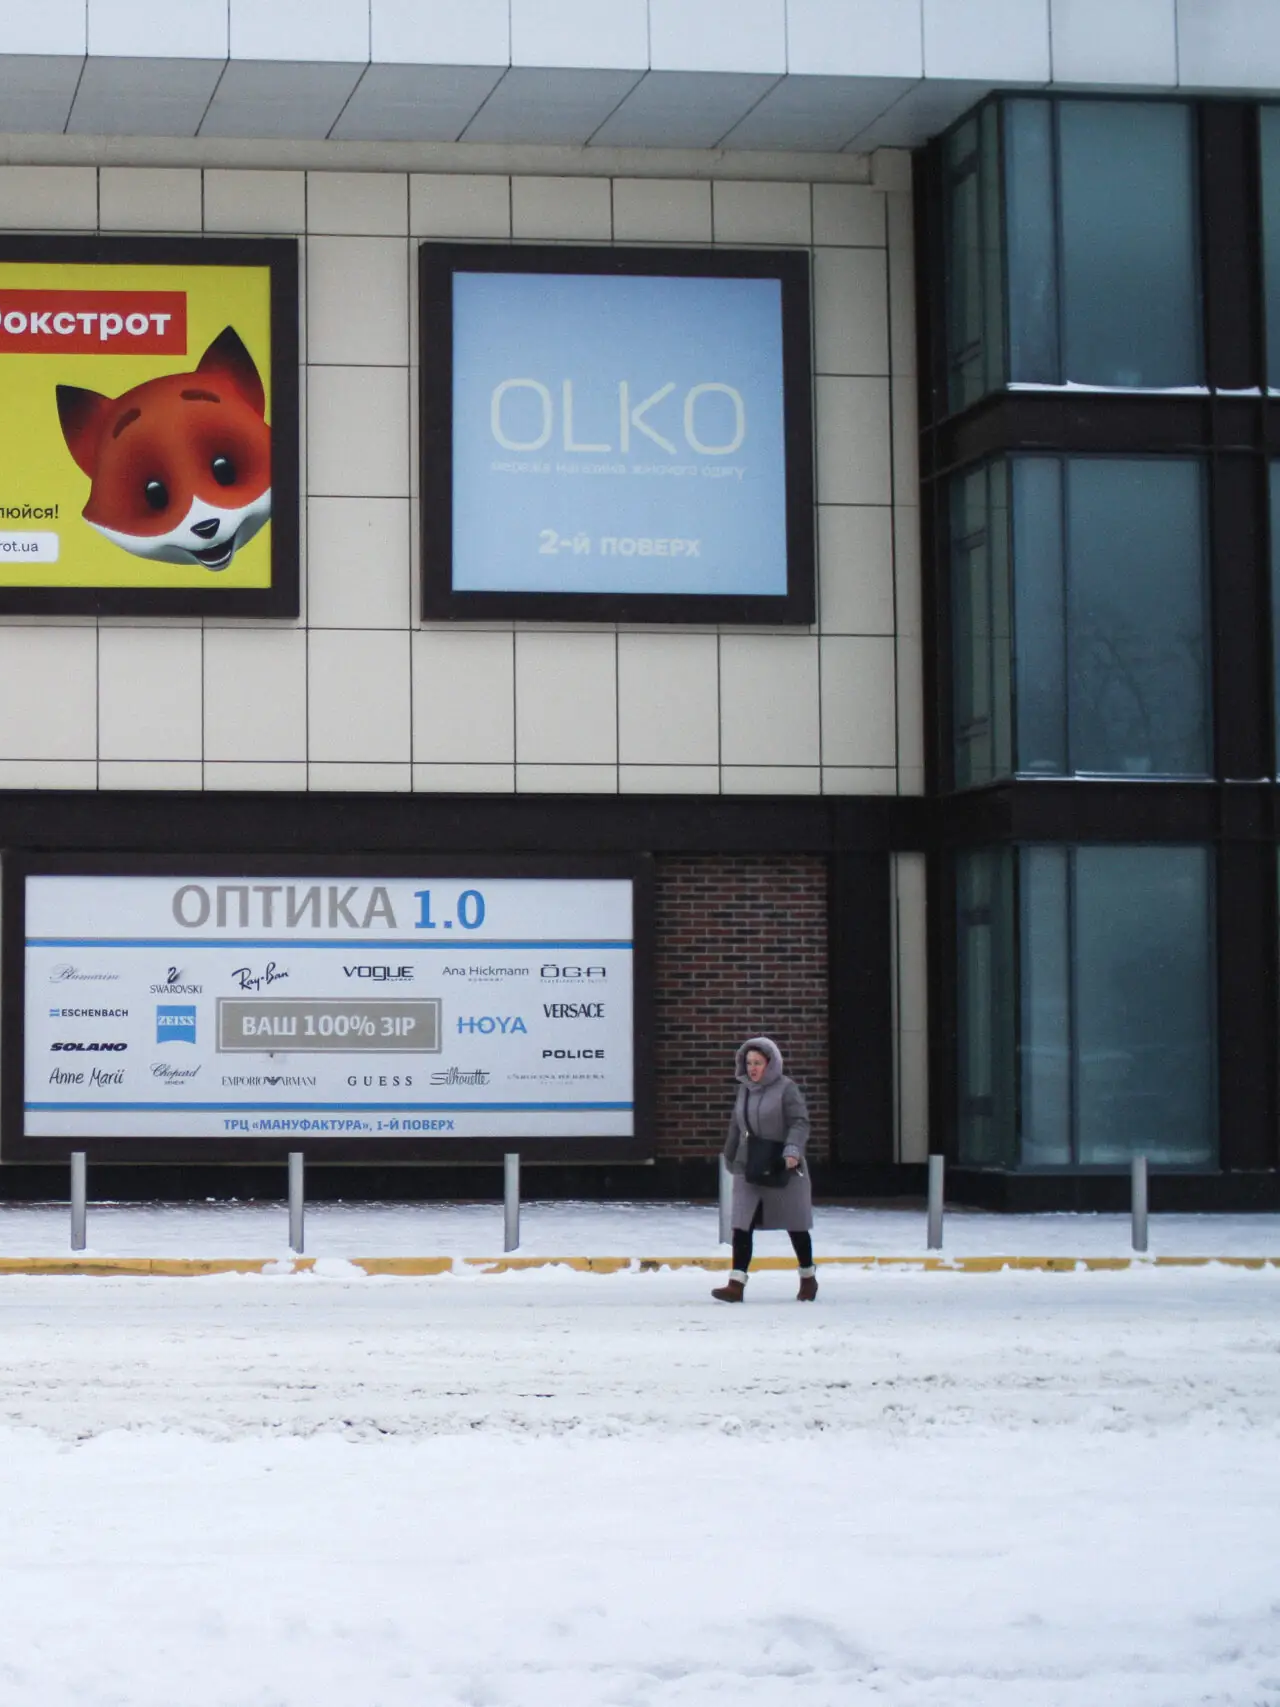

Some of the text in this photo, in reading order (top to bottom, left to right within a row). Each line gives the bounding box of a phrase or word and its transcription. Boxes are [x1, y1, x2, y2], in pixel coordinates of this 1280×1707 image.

[490, 378, 746, 455] OLKO
[172, 884, 486, 930] ОПТИКА 1.0
[231, 962, 289, 991] Ray-Ban
[343, 966, 414, 981] VOGUE
[442, 966, 529, 976] Ana Hickmann
[150, 984, 203, 994] SWAROVSKI
[61, 1008, 128, 1017] ESCHENBACH
[543, 1003, 605, 1018] VERSACE
[157, 1015, 194, 1026] ZEISS
[242, 1015, 416, 1037] ВАШ 100% ЗІР
[456, 1016, 528, 1034] HOYA
[50, 1042, 128, 1052] SOLANO
[542, 1049, 605, 1059] POLICE
[48, 1067, 84, 1085] Anne
[221, 1076, 317, 1086] EMPORIO ARMANI
[429, 1066, 491, 1086] Silhouette
[224, 1118, 454, 1132] ТРЦ «МАНУФАКТУРА», 1-Й ПОВЕРХ
